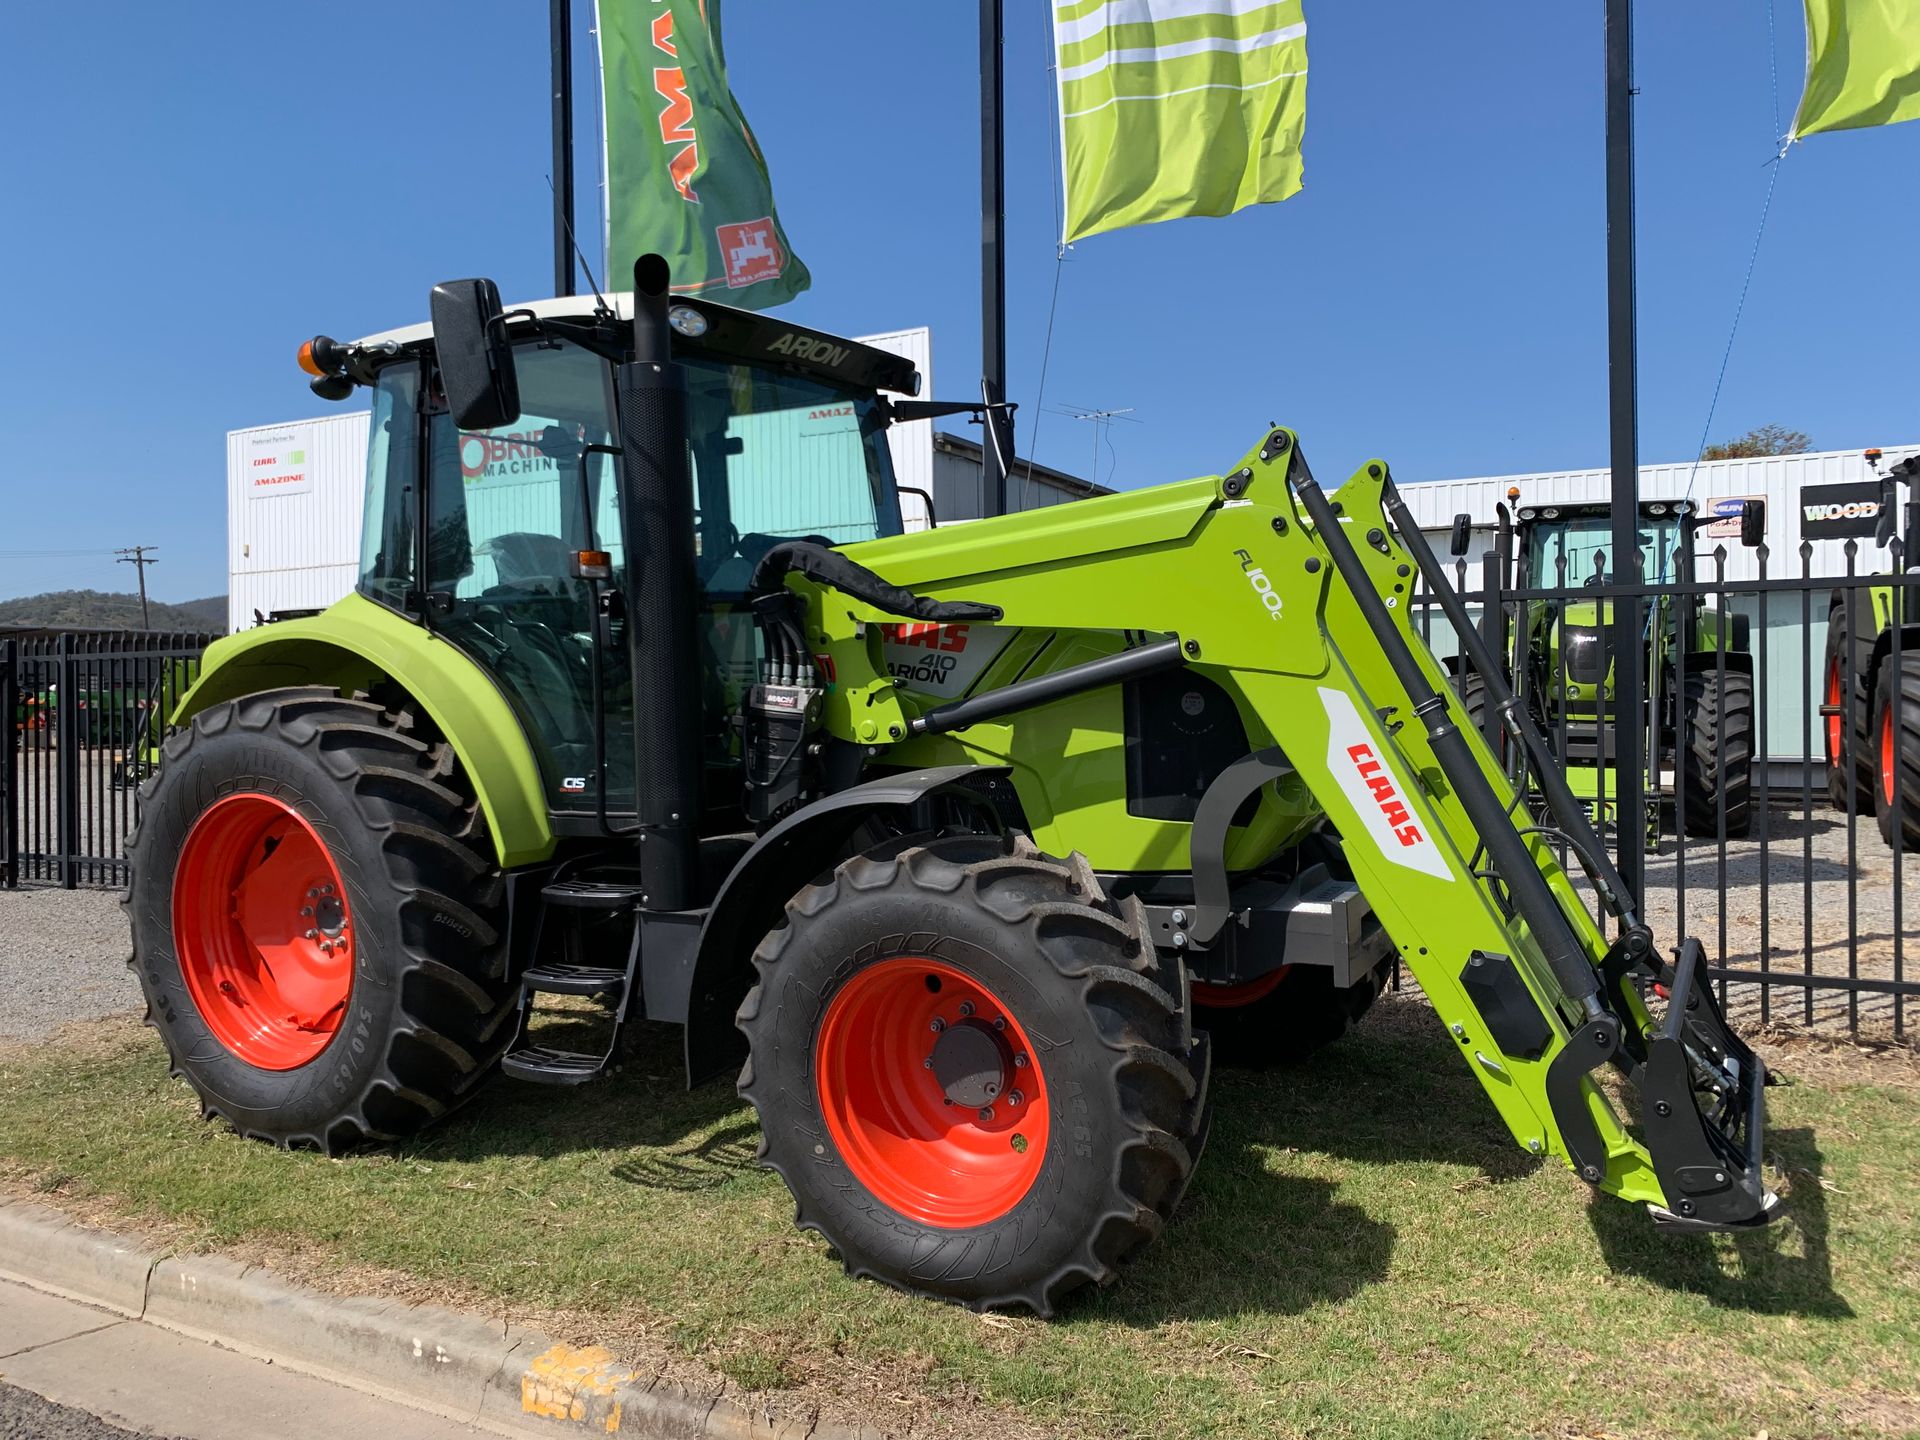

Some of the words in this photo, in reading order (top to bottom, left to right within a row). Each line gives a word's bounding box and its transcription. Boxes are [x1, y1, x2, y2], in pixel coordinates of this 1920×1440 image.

[766, 333, 851, 368] ARION
[808, 406, 854, 420] AMAZ
[253, 457, 277, 467] CLAAS
[254, 473, 305, 486] AMAZONE
[918, 654, 957, 671] 410
[887, 662, 947, 684] ARION
[563, 777, 586, 788] CIS
[1347, 743, 1424, 847] CLAAS
